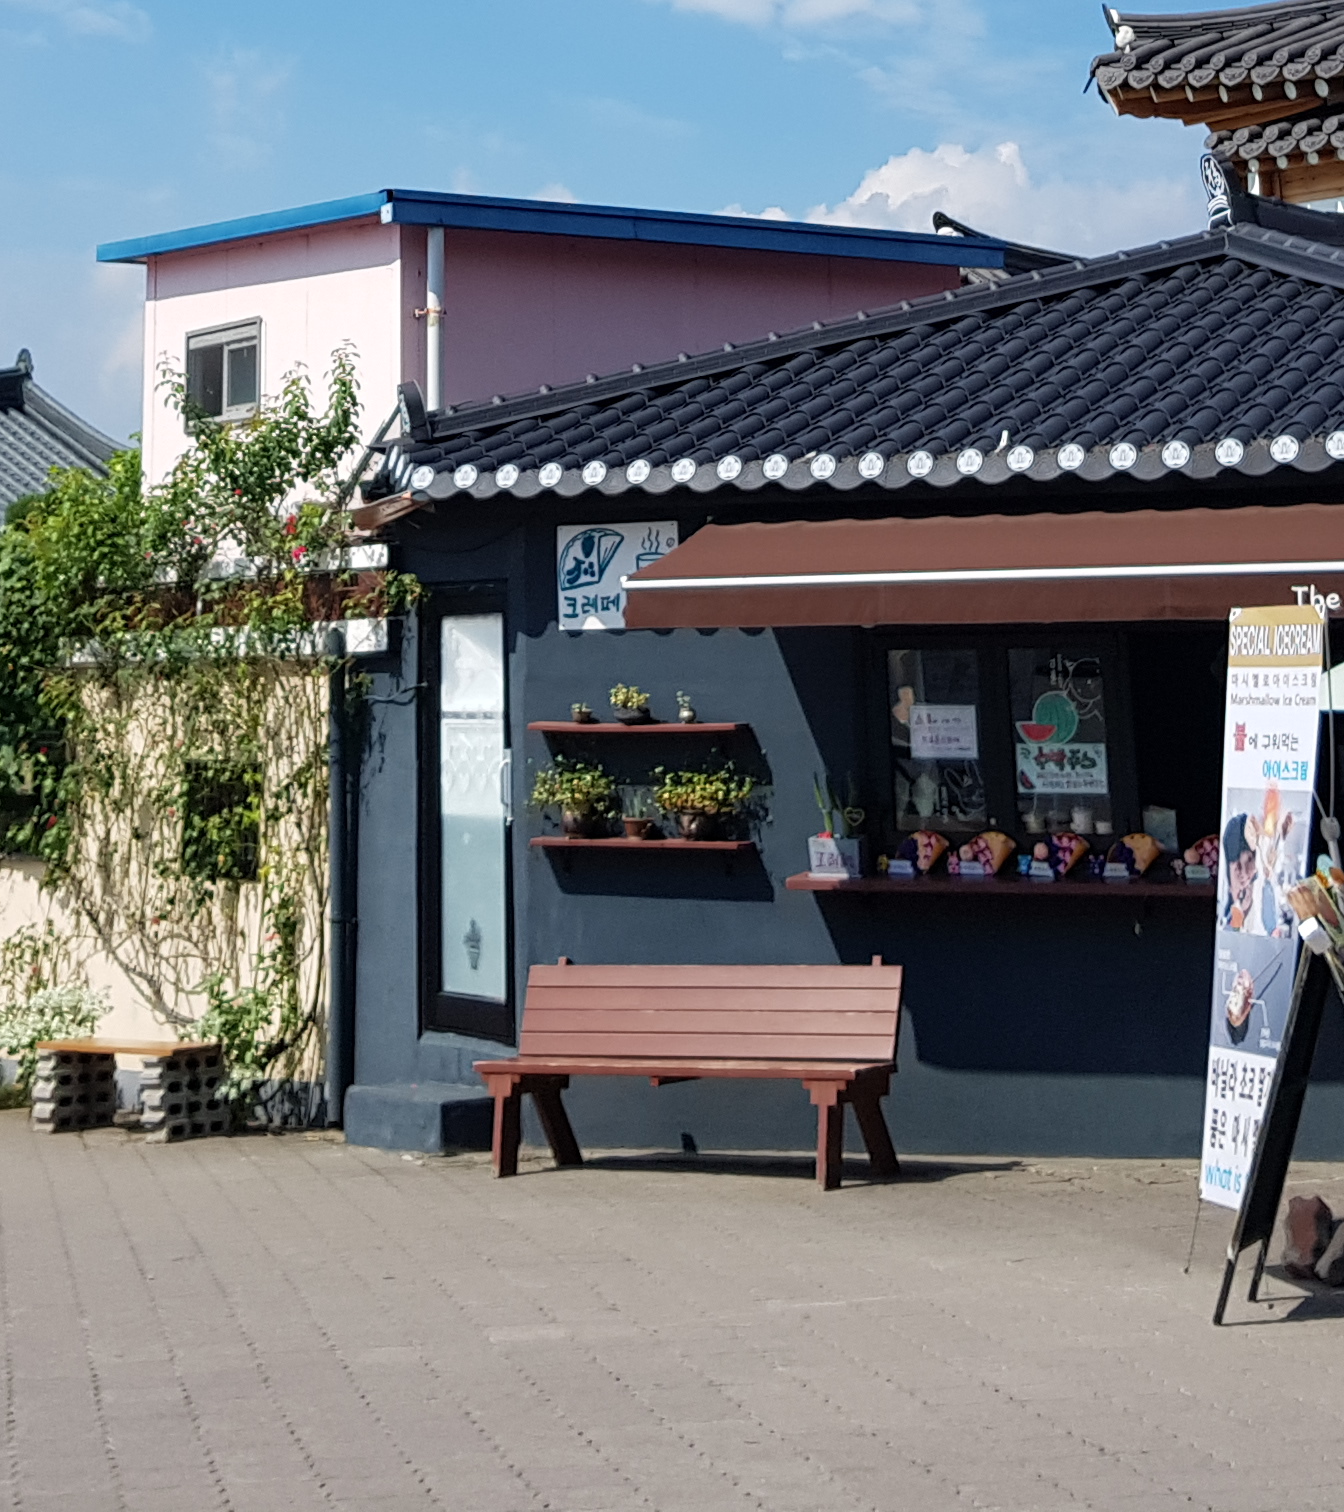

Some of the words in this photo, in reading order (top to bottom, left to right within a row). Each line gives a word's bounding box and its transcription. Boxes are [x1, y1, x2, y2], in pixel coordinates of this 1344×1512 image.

[1291, 584, 1341, 610] The
[1230, 624, 1270, 656] SPECIAL
[1272, 622, 1321, 656] ICECREAM
[1231, 692, 1280, 706] Marshmallow
[1283, 693, 1292, 706] Ice
[1294, 693, 1316, 706] Cream
[1262, 759, 1308, 781] 아이스크림
[1239, 1063, 1255, 1101] 초코
[1206, 1158, 1233, 1191] what
[1234, 1165, 1242, 1194] is
